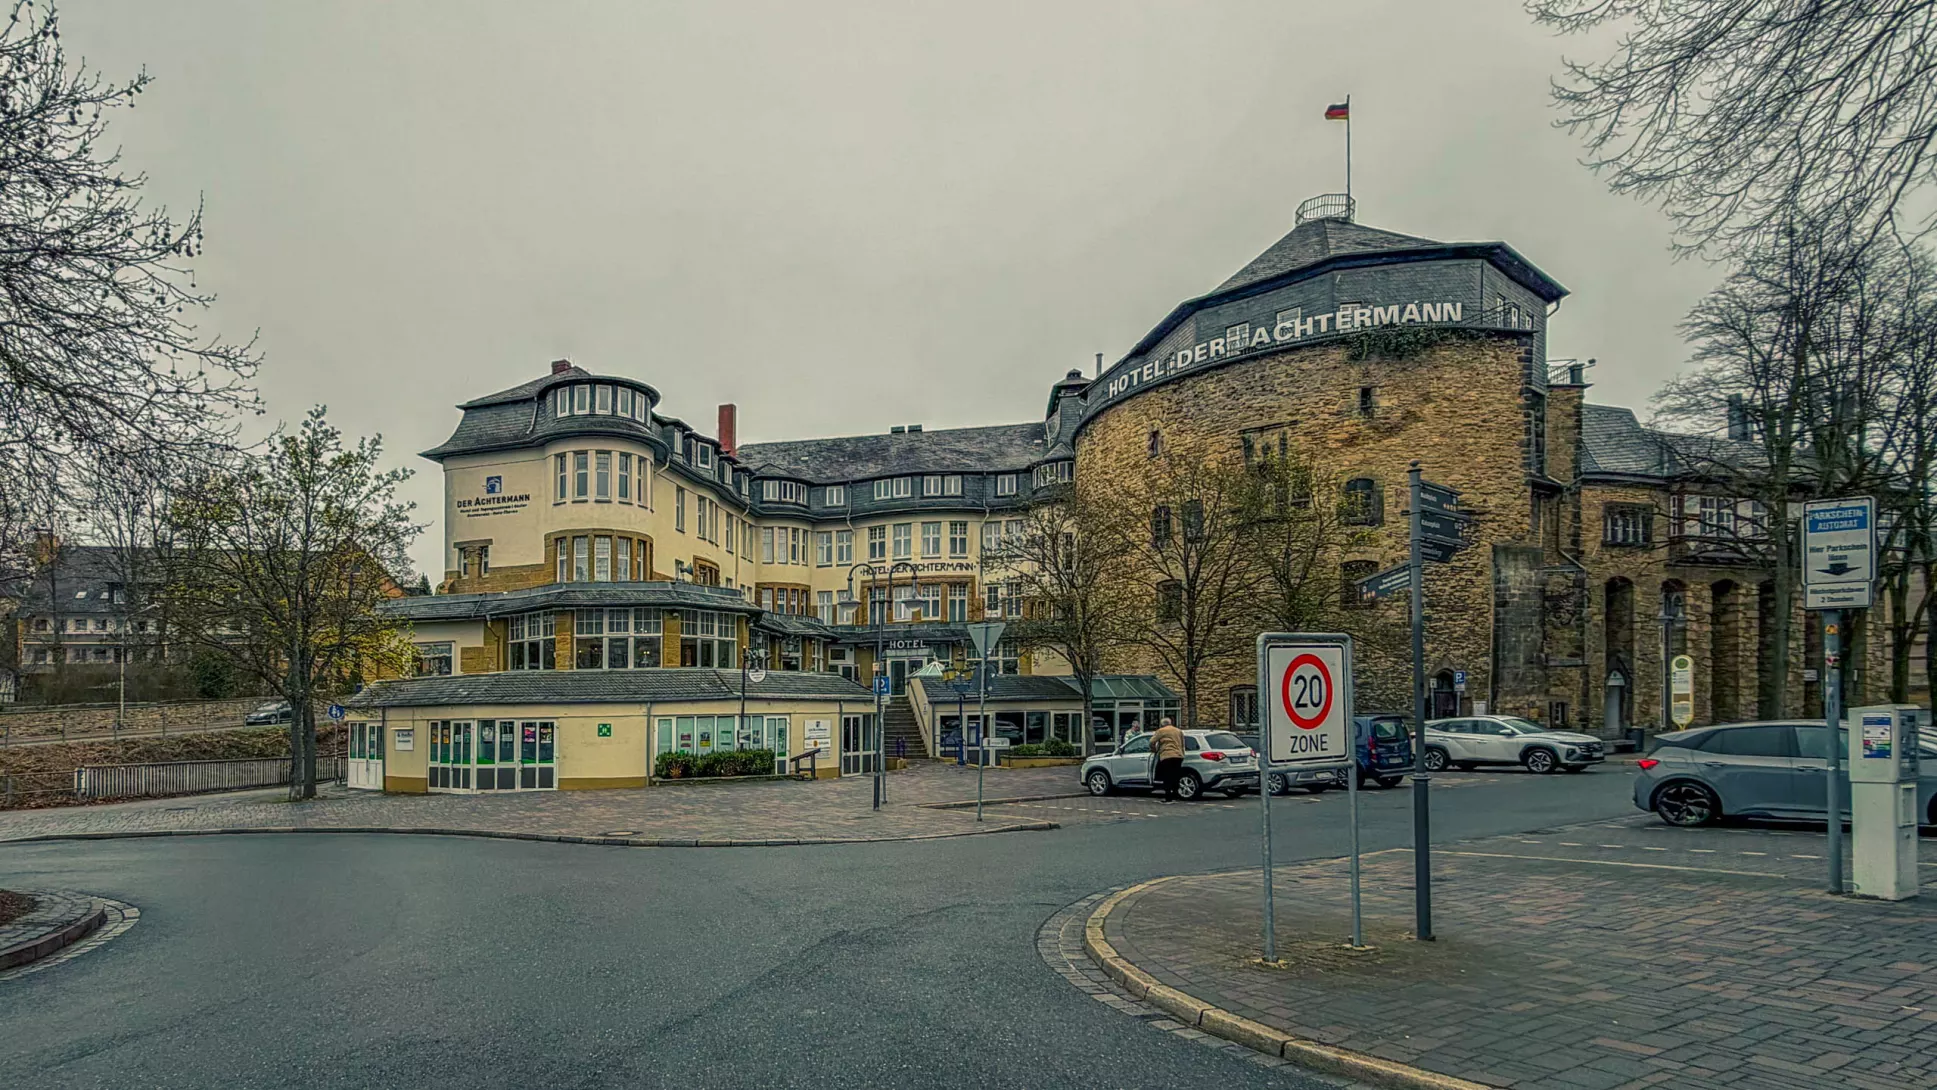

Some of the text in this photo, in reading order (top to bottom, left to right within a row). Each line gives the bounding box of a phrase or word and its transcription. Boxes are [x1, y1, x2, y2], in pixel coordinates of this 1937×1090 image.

[1109, 301, 1463, 398] HOTEL DER ACHTERMANN
[457, 494, 530, 508] DER ACHTERMANN
[889, 640, 926, 649] HOTEL
[1294, 674, 1323, 709] 20
[1290, 733, 1329, 754] ZONE
